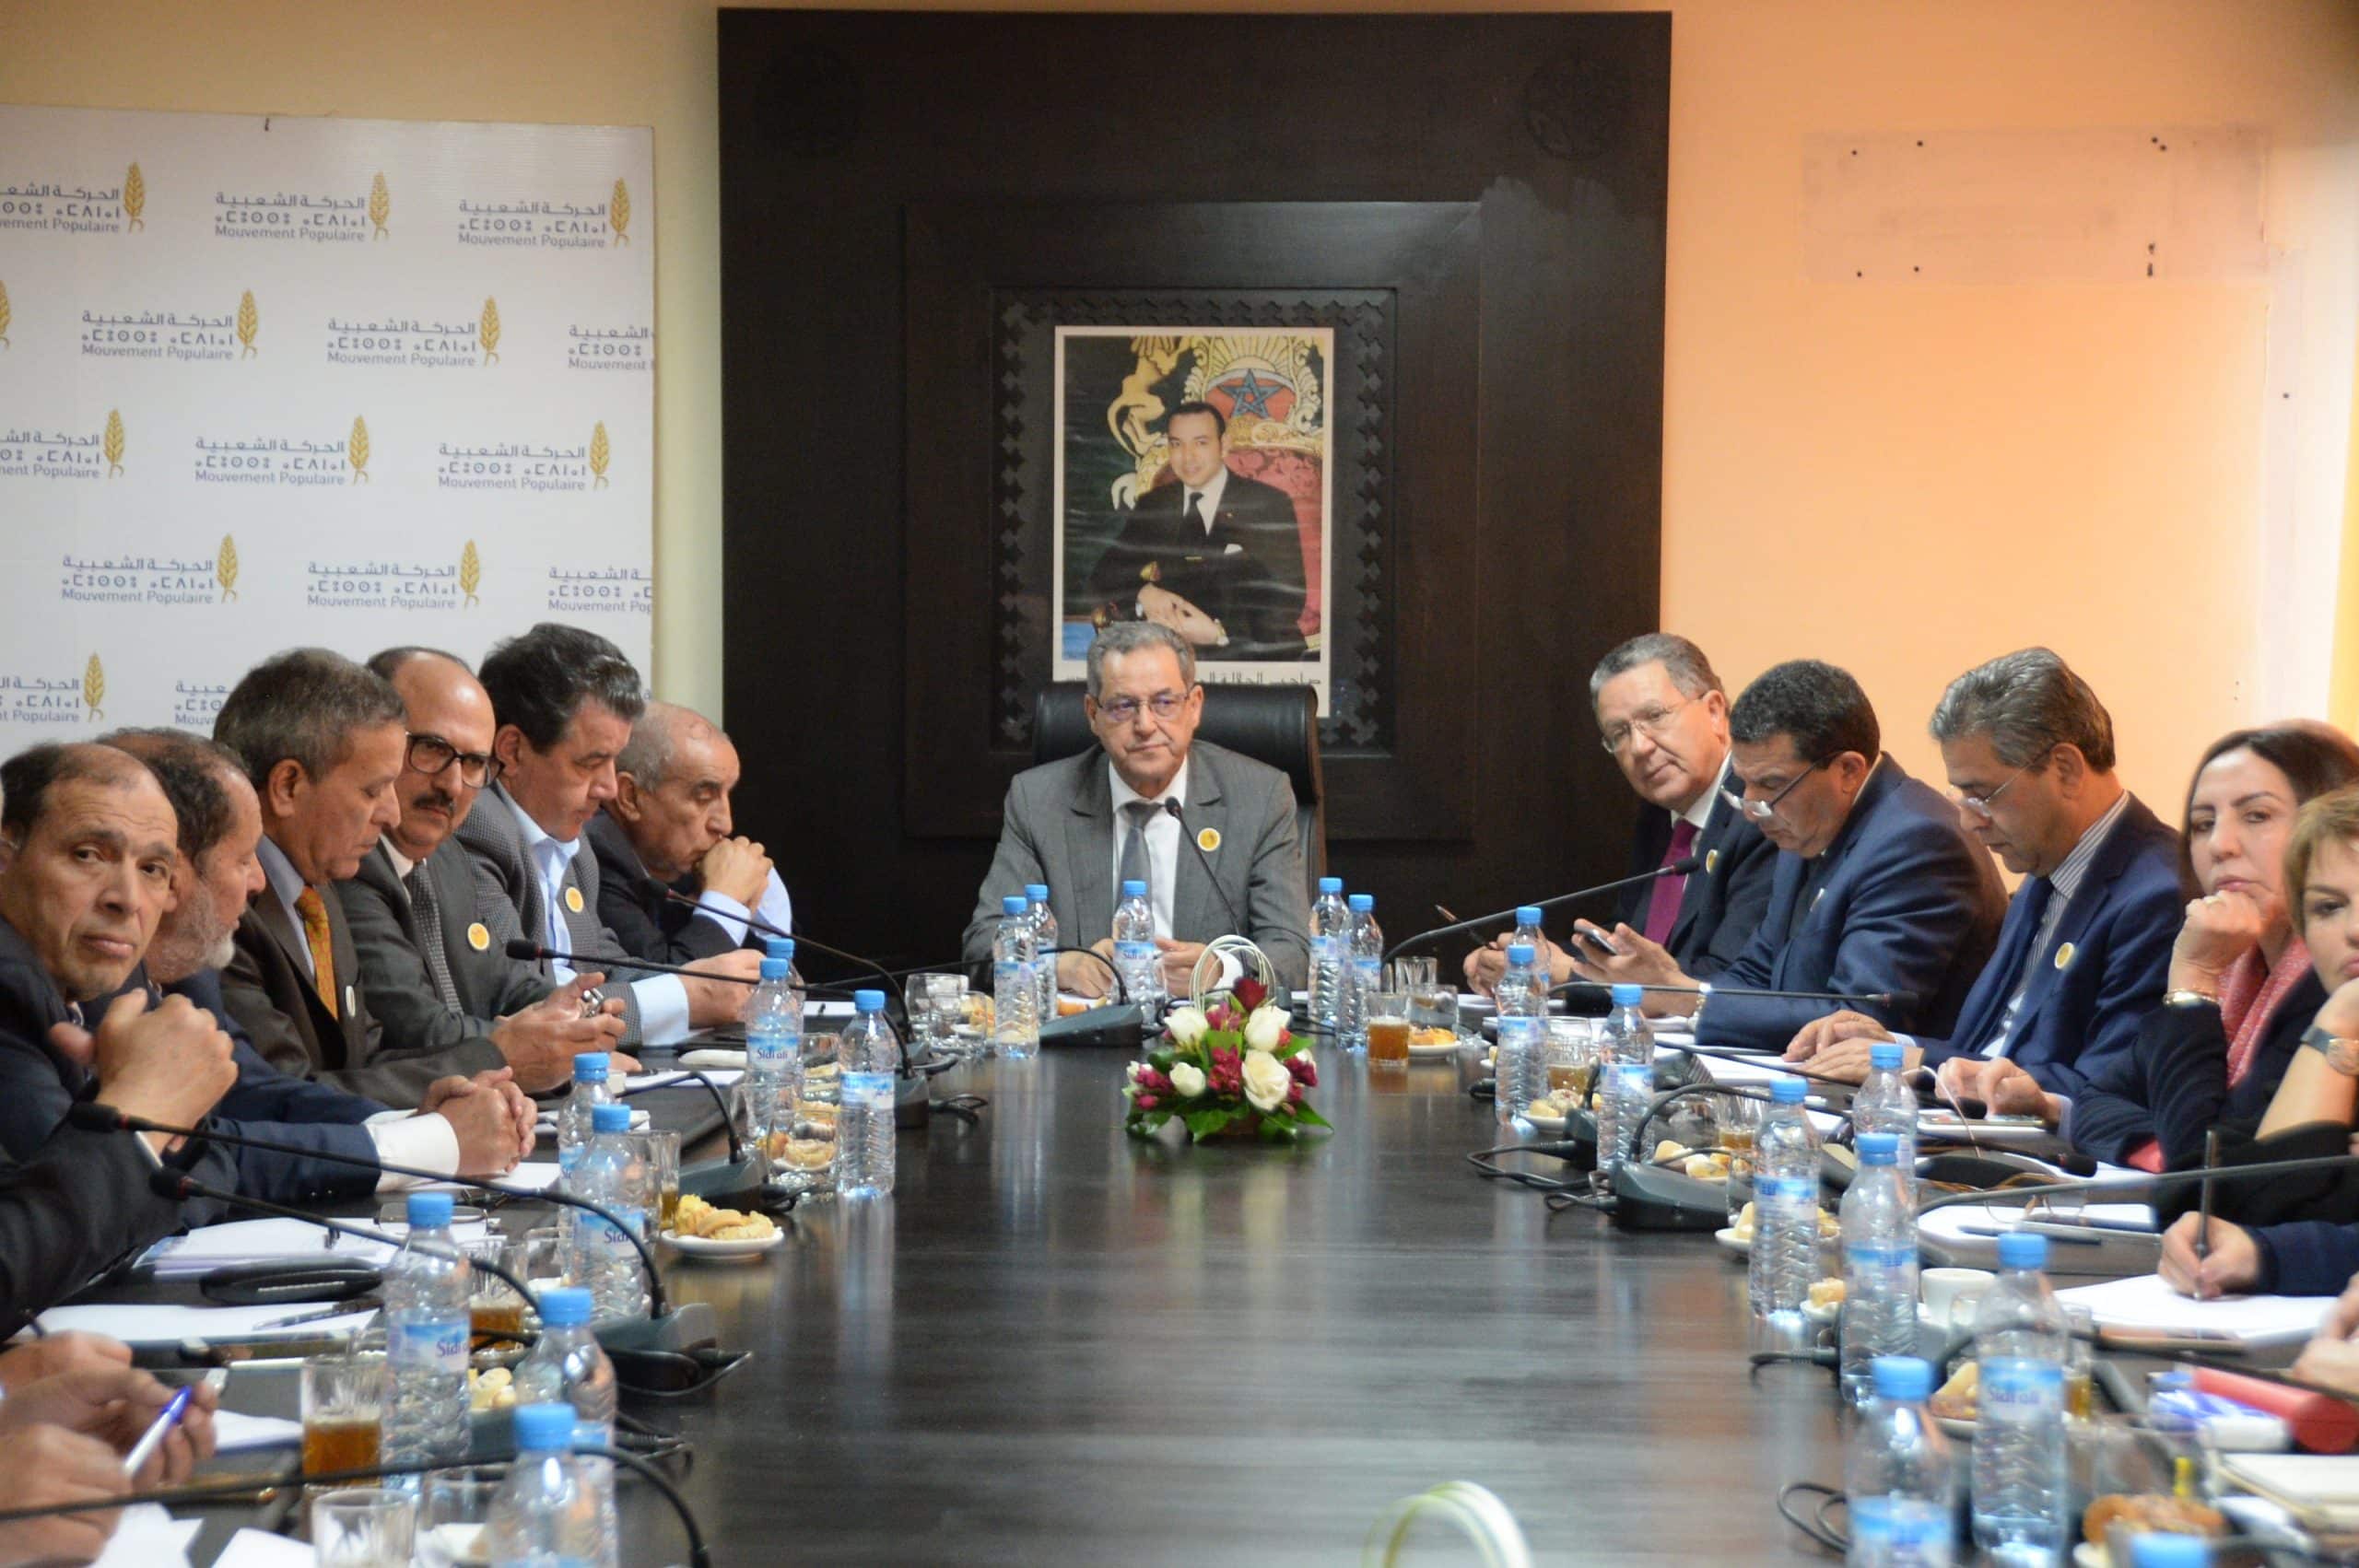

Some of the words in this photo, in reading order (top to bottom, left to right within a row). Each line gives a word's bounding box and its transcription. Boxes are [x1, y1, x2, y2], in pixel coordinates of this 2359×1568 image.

[53, 185, 119, 202] الحركة
[216, 192, 298, 208] الشعبية
[300, 194, 365, 210] الحركة
[459, 199, 540, 215] الشعبية
[542, 201, 605, 216] الحركة
[0, 219, 48, 229] ement
[53, 218, 120, 233] Populaire
[216, 225, 295, 238] Mouvement
[299, 228, 366, 242] Populaire
[458, 232, 536, 245] Mouvement
[541, 234, 605, 249] Populaire
[82, 310, 165, 326] الشعبية
[168, 312, 232, 328] الحركة
[328, 318, 408, 333] الشعبية
[411, 321, 475, 335] الحركة
[569, 324, 648, 340] الشعبية
[82, 344, 162, 357] Mouvement
[168, 346, 233, 361] Populaire
[327, 351, 405, 364] Mouvement
[410, 353, 475, 368] Populaire
[568, 357, 647, 370] Mouvement
[33, 431, 99, 446] الحركة
[195, 437, 276, 452] الشعبية
[280, 439, 345, 454] الحركة
[439, 442, 518, 459] الشعبية
[522, 445, 585, 461] الحركة
[33, 463, 100, 478] Populaire
[195, 470, 276, 483] Mouvement
[280, 472, 345, 486] Populaire
[439, 475, 516, 488] Mouvement
[521, 477, 585, 492] Populaire
[63, 555, 144, 571] الشعبية
[147, 558, 213, 573] الحركة
[308, 561, 388, 578] الشعبية
[392, 564, 455, 579] الحركة
[549, 567, 628, 582] الشعبية
[62, 589, 142, 602] Mouvement
[147, 591, 213, 606] Populaire
[308, 594, 386, 607] Mouvement
[391, 595, 456, 611] Populaire
[548, 600, 627, 612] Mouvement
[14, 676, 79, 691] الحركة
[13, 709, 79, 724] Populaire
